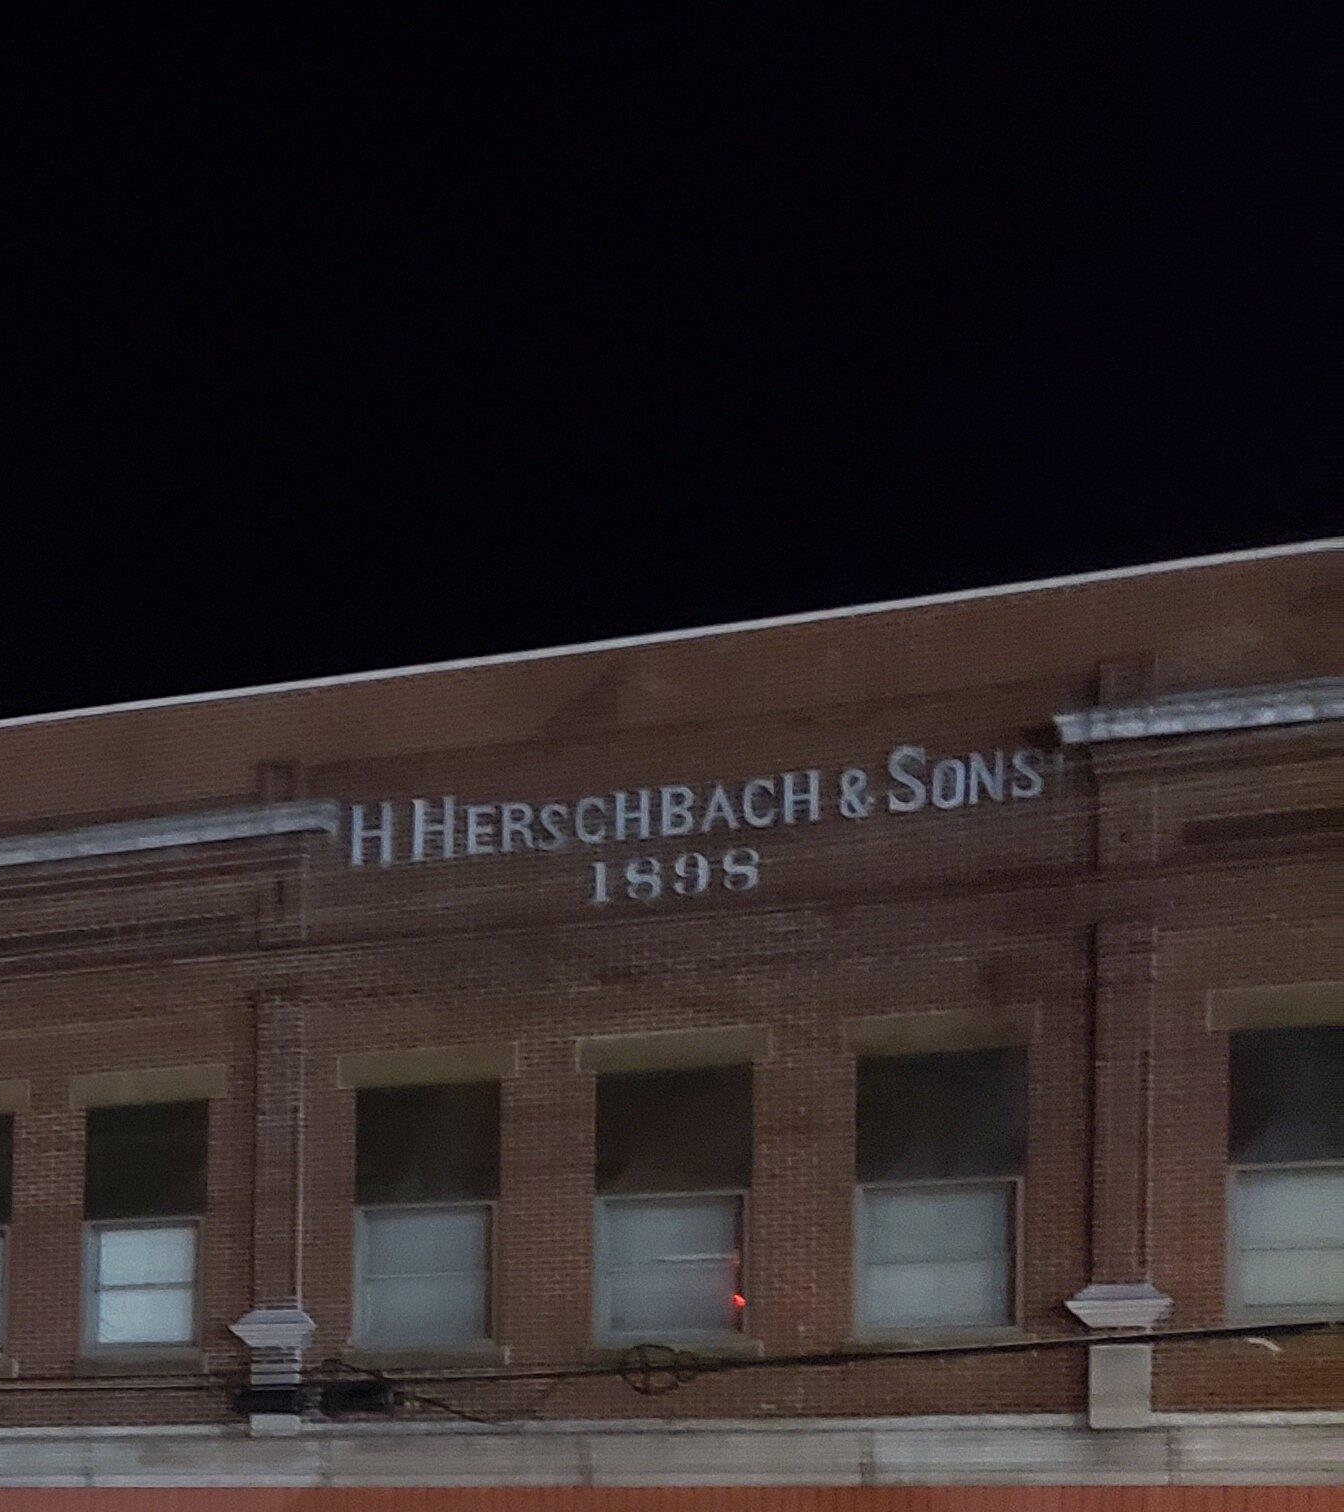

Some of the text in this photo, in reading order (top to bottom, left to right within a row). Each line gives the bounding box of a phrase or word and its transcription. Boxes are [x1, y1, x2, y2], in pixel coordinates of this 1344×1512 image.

[411, 769, 822, 863] HERSCHBACH
[838, 768, 875, 819] &
[888, 744, 1044, 814] SONS
[591, 848, 761, 904] 1898
